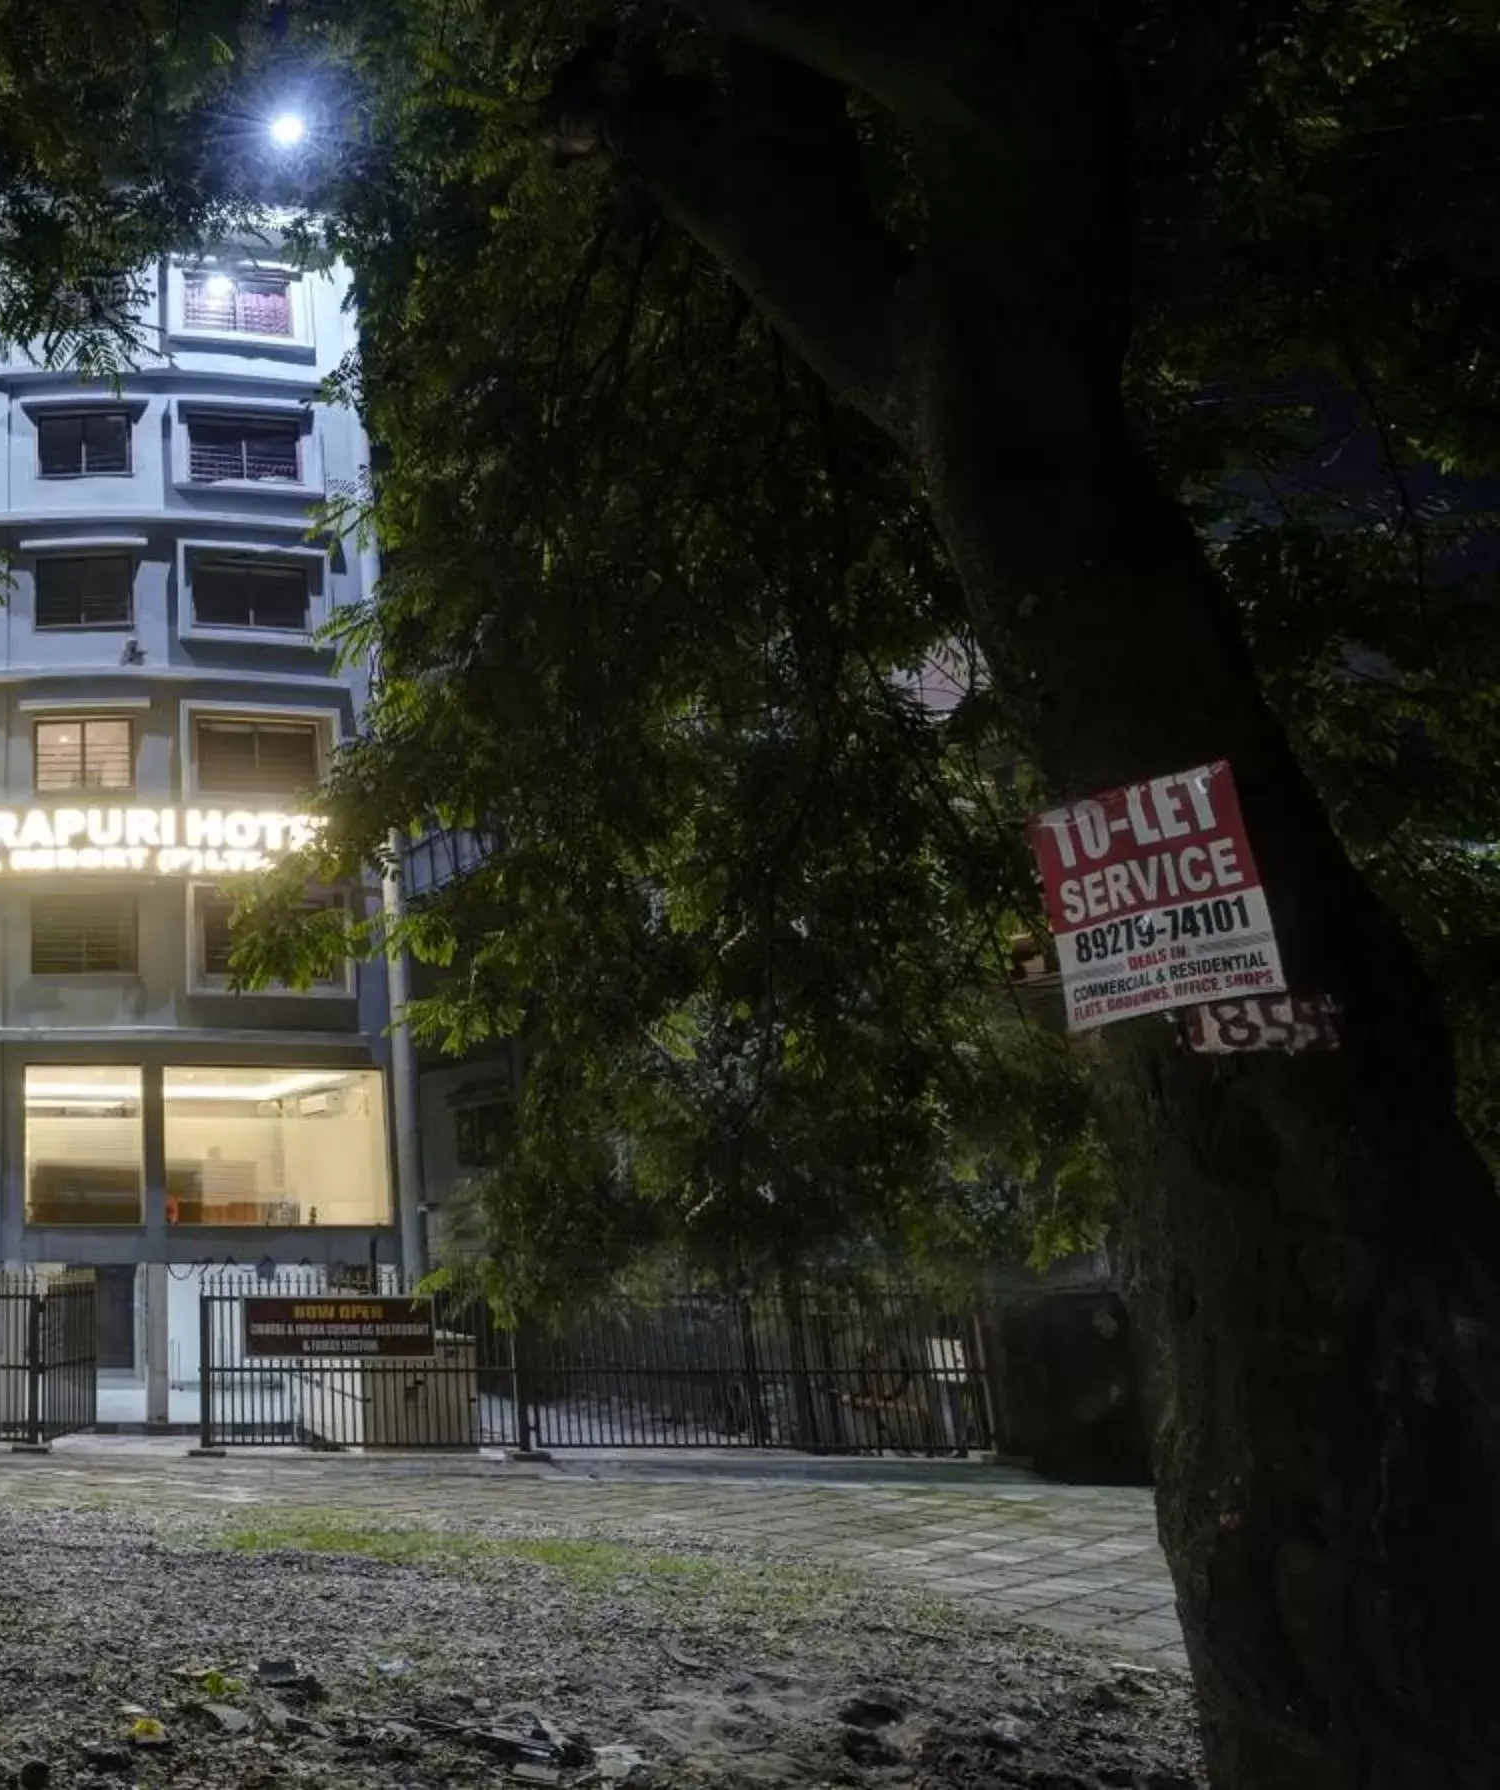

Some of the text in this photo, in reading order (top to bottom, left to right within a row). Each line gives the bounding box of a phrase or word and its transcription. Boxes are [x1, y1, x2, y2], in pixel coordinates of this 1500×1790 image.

[1040, 764, 1217, 869] TO-LET
[1059, 837, 1245, 924] SERVICE
[1074, 895, 1252, 963] 89279-74101
[1073, 950, 1269, 1003] COMMERCIAL & RESIDENTIAL
[1127, 947, 1168, 971] DEALS
[1225, 970, 1275, 989] SHOPS
[293, 1304, 384, 1320] NOW OPEN
